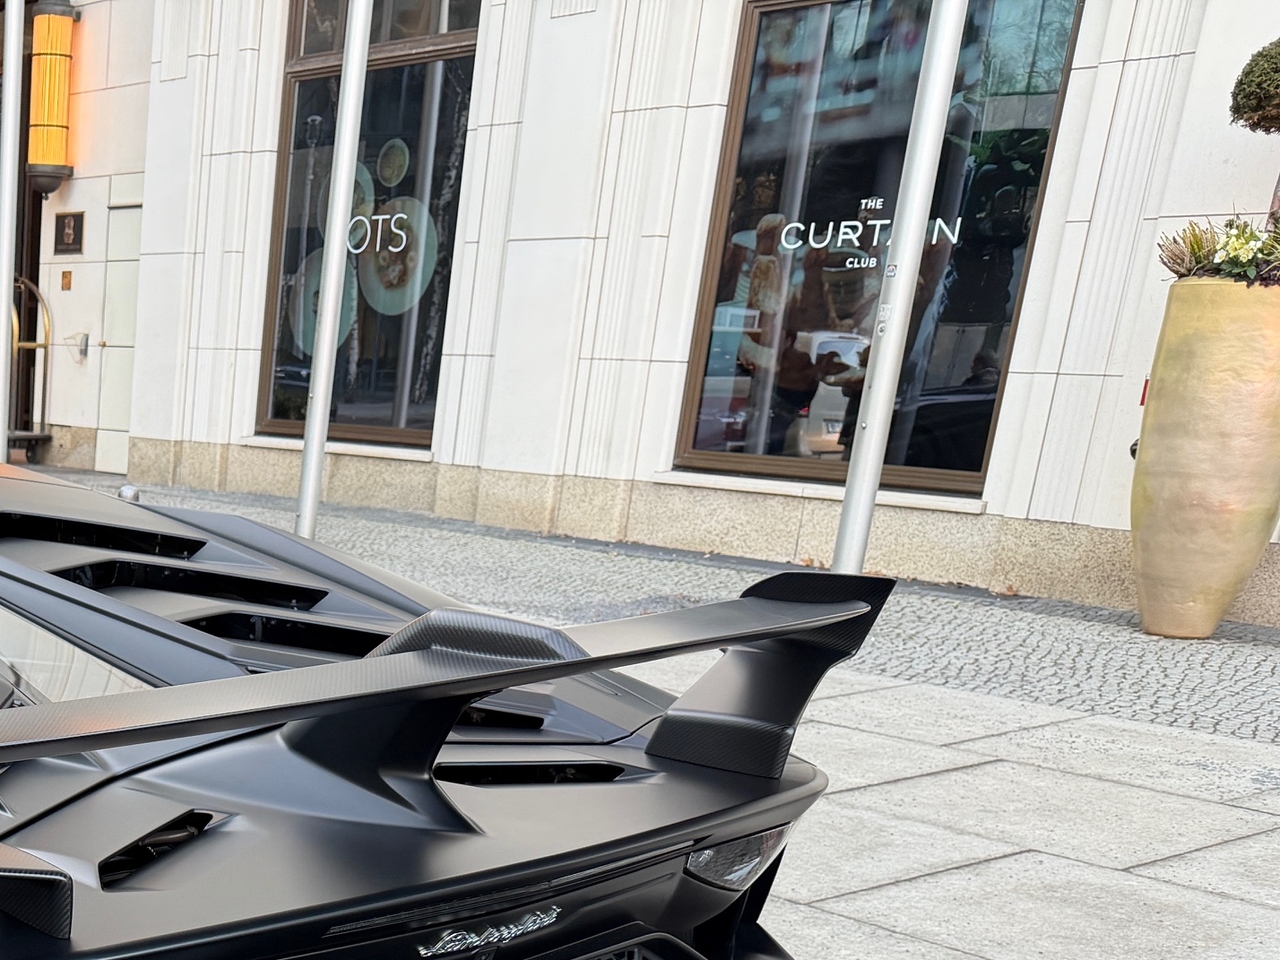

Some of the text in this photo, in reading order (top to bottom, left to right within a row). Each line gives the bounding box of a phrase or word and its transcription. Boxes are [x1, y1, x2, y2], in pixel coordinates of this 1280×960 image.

[860, 199, 884, 210] THE
[780, 216, 962, 249] CURTN
[845, 257, 878, 269] CLUB
